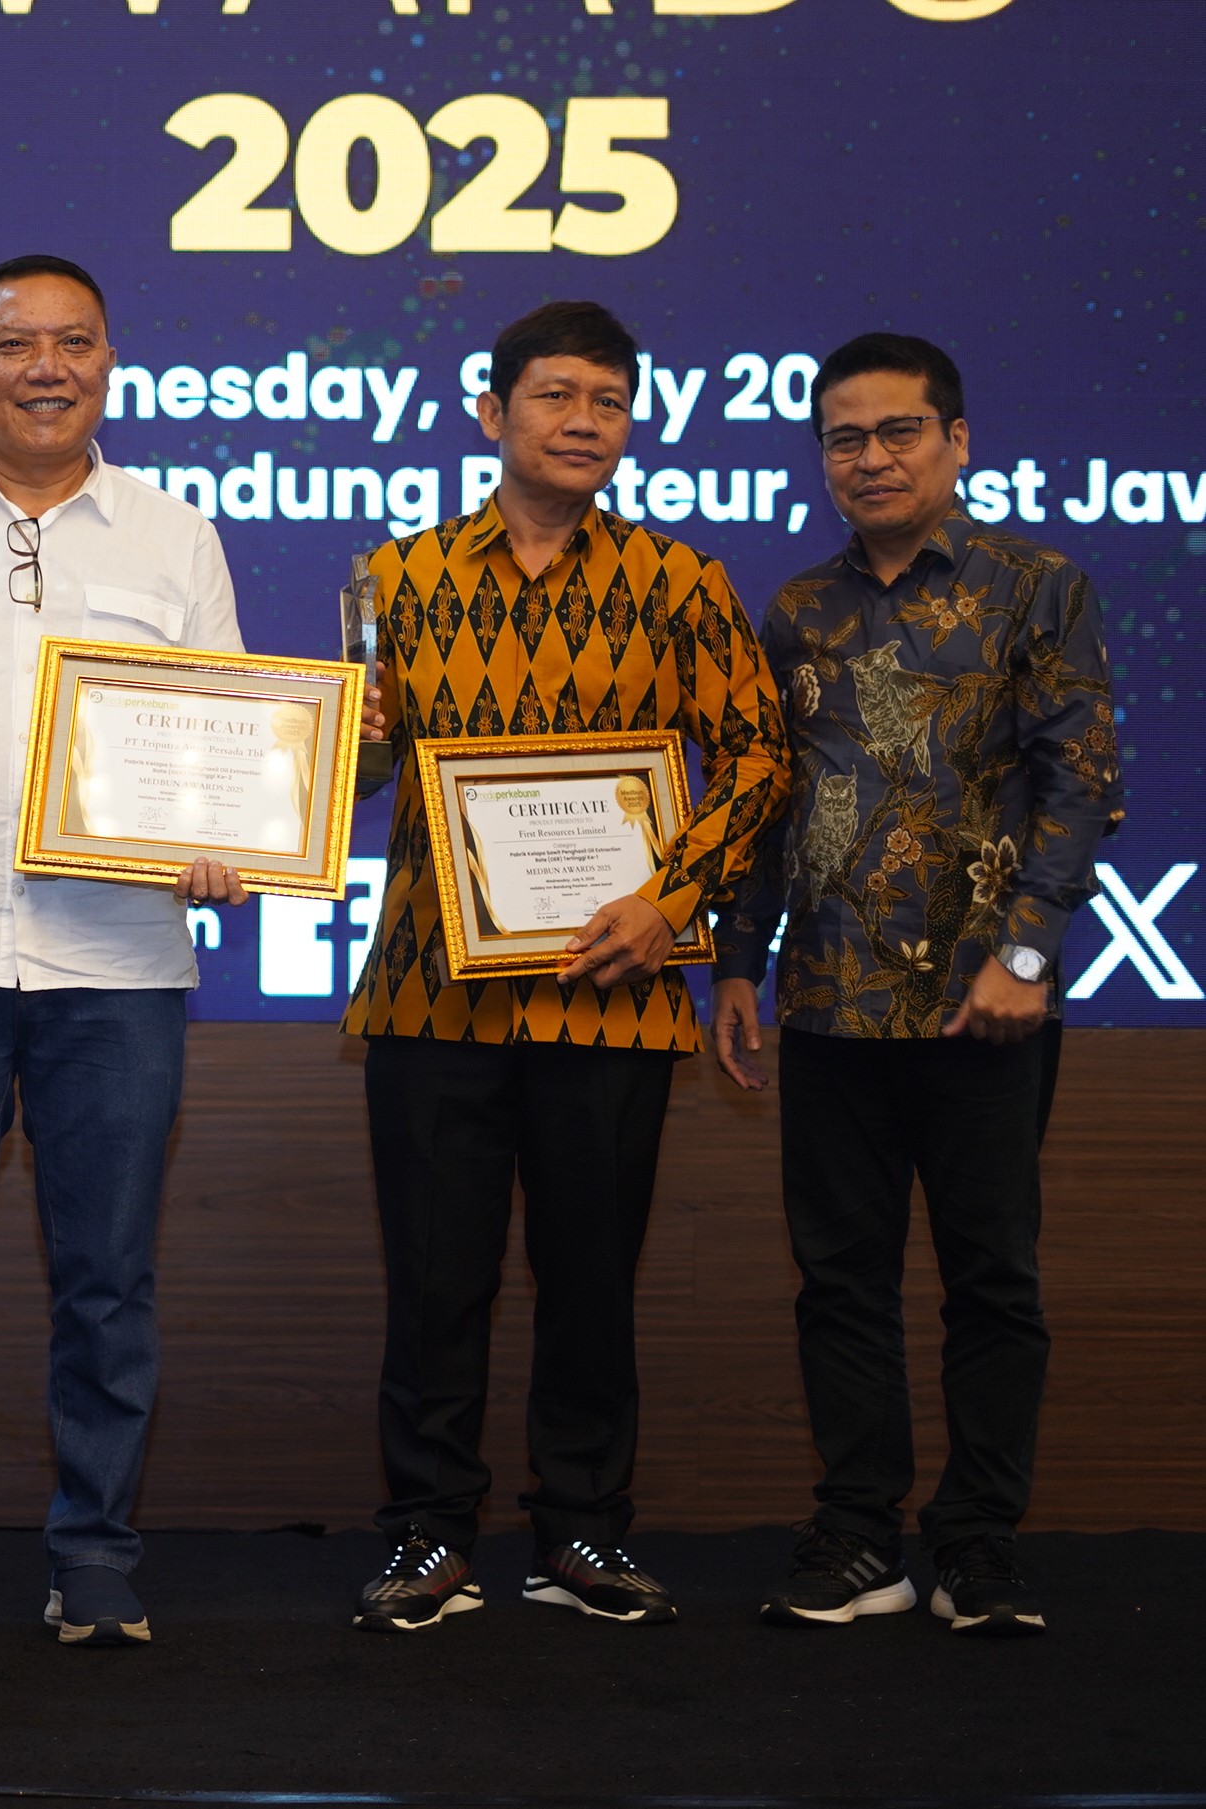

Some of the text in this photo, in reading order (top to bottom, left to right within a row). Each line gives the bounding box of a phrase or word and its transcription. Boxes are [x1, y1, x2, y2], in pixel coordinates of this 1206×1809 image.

[164, 93, 679, 256] 2025
[723, 353, 820, 420] 20
[461, 456, 808, 533] Pteur,
[124, 737, 138, 746] PT
[209, 745, 244, 757] Persada
[246, 748, 265, 758] Tbk
[138, 777, 180, 788] MEDBUN
[225, 785, 244, 793] 2025
[508, 800, 610, 818] CERTIFICATE
[519, 826, 607, 838] First Resources Limited
[526, 864, 612, 876] MEDBUN AWARDS 2025
